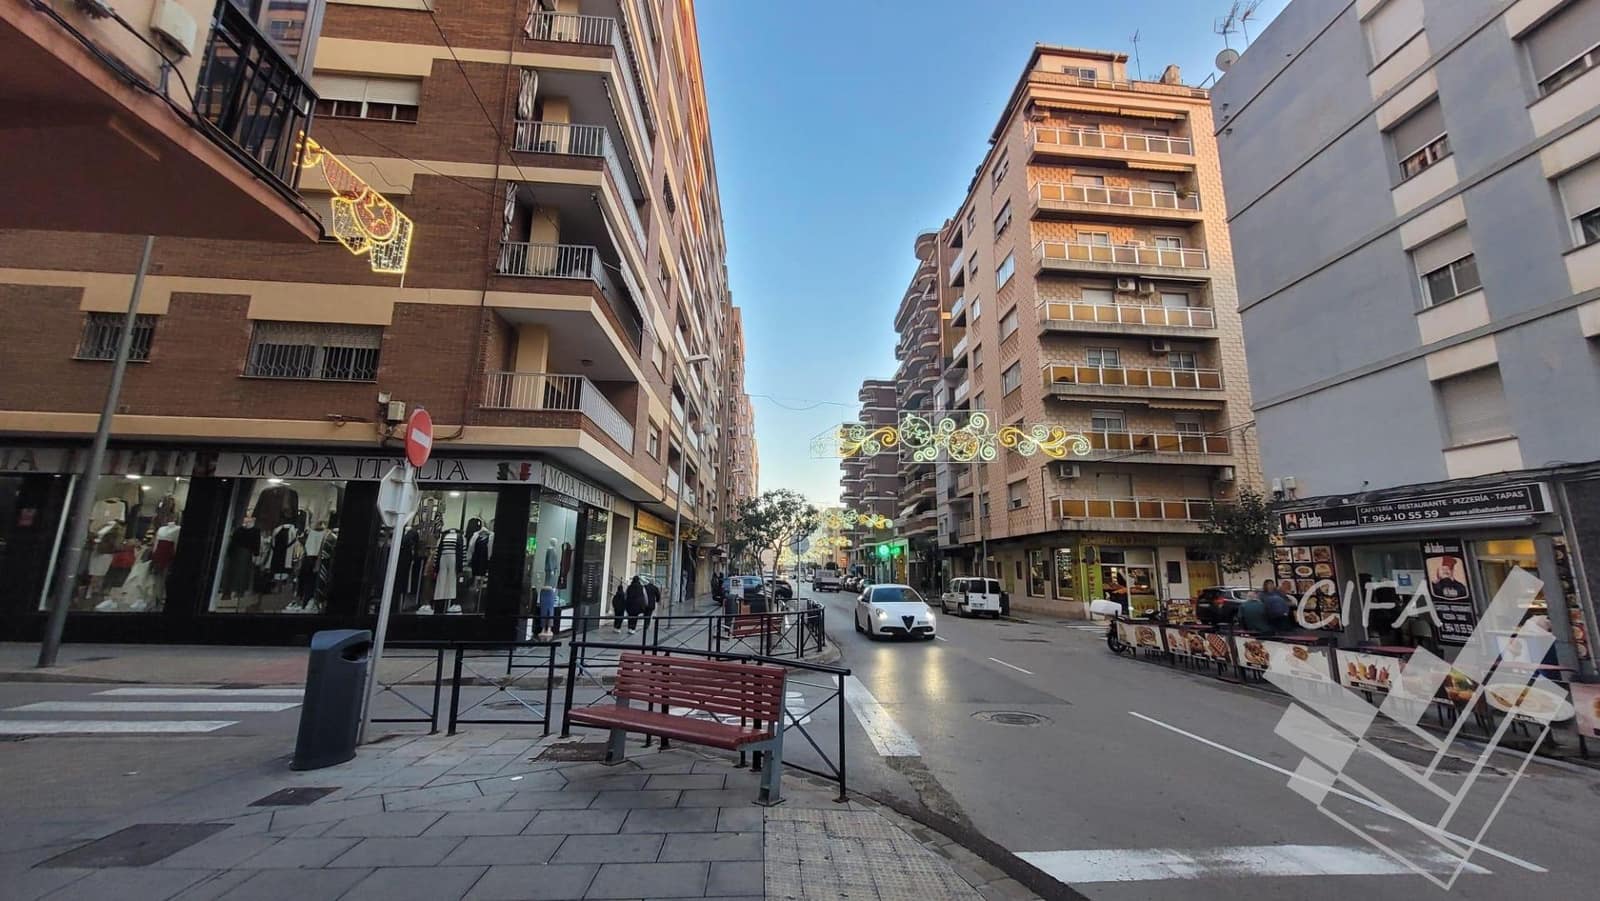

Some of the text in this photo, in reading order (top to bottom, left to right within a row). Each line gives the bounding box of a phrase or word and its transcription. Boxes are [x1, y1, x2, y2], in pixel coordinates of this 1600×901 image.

[238, 455, 469, 480] MODA ITLIA
[545, 464, 575, 497] MODA
[1495, 490, 1525, 500] TAPAS
[1372, 514, 1391, 523] 964
[1393, 512, 1406, 521] 10
[1408, 511, 1422, 520] 55
[1424, 510, 1439, 519] 59
